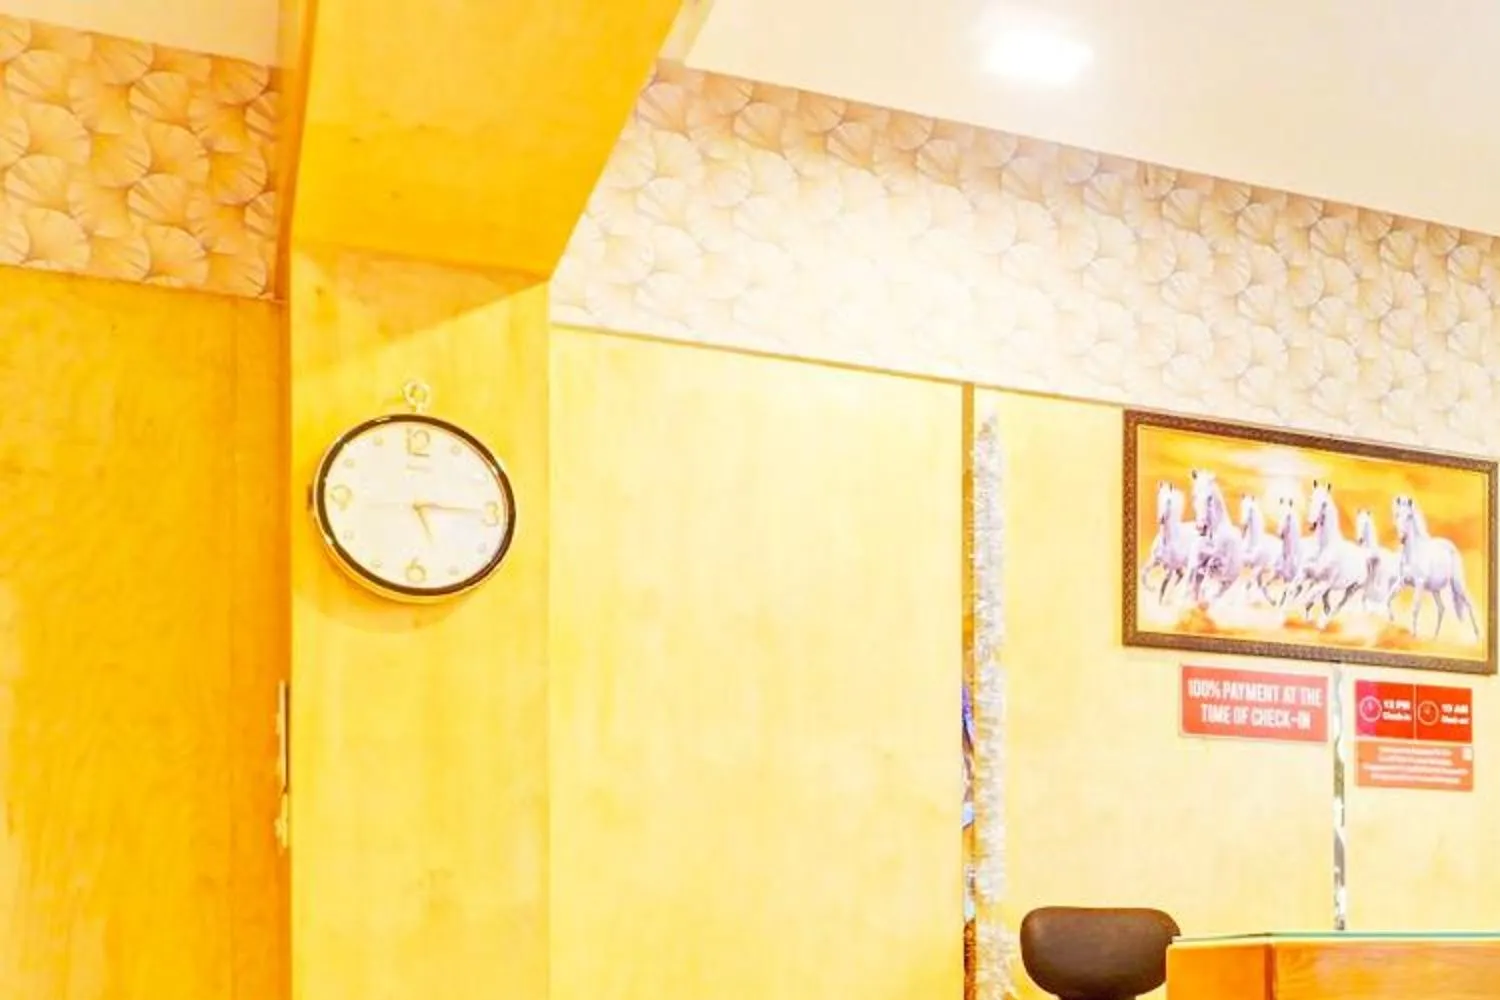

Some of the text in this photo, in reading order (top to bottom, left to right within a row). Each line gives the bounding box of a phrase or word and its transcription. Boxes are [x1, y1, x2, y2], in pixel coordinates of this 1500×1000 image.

[406, 428, 431, 457] 12
[481, 500, 500, 528] 3
[405, 556, 427, 584] 6
[1188, 679, 1323, 707] 100% PAYMENT AT THE
[1201, 703, 1311, 731] TIME OF CHECK-IN
